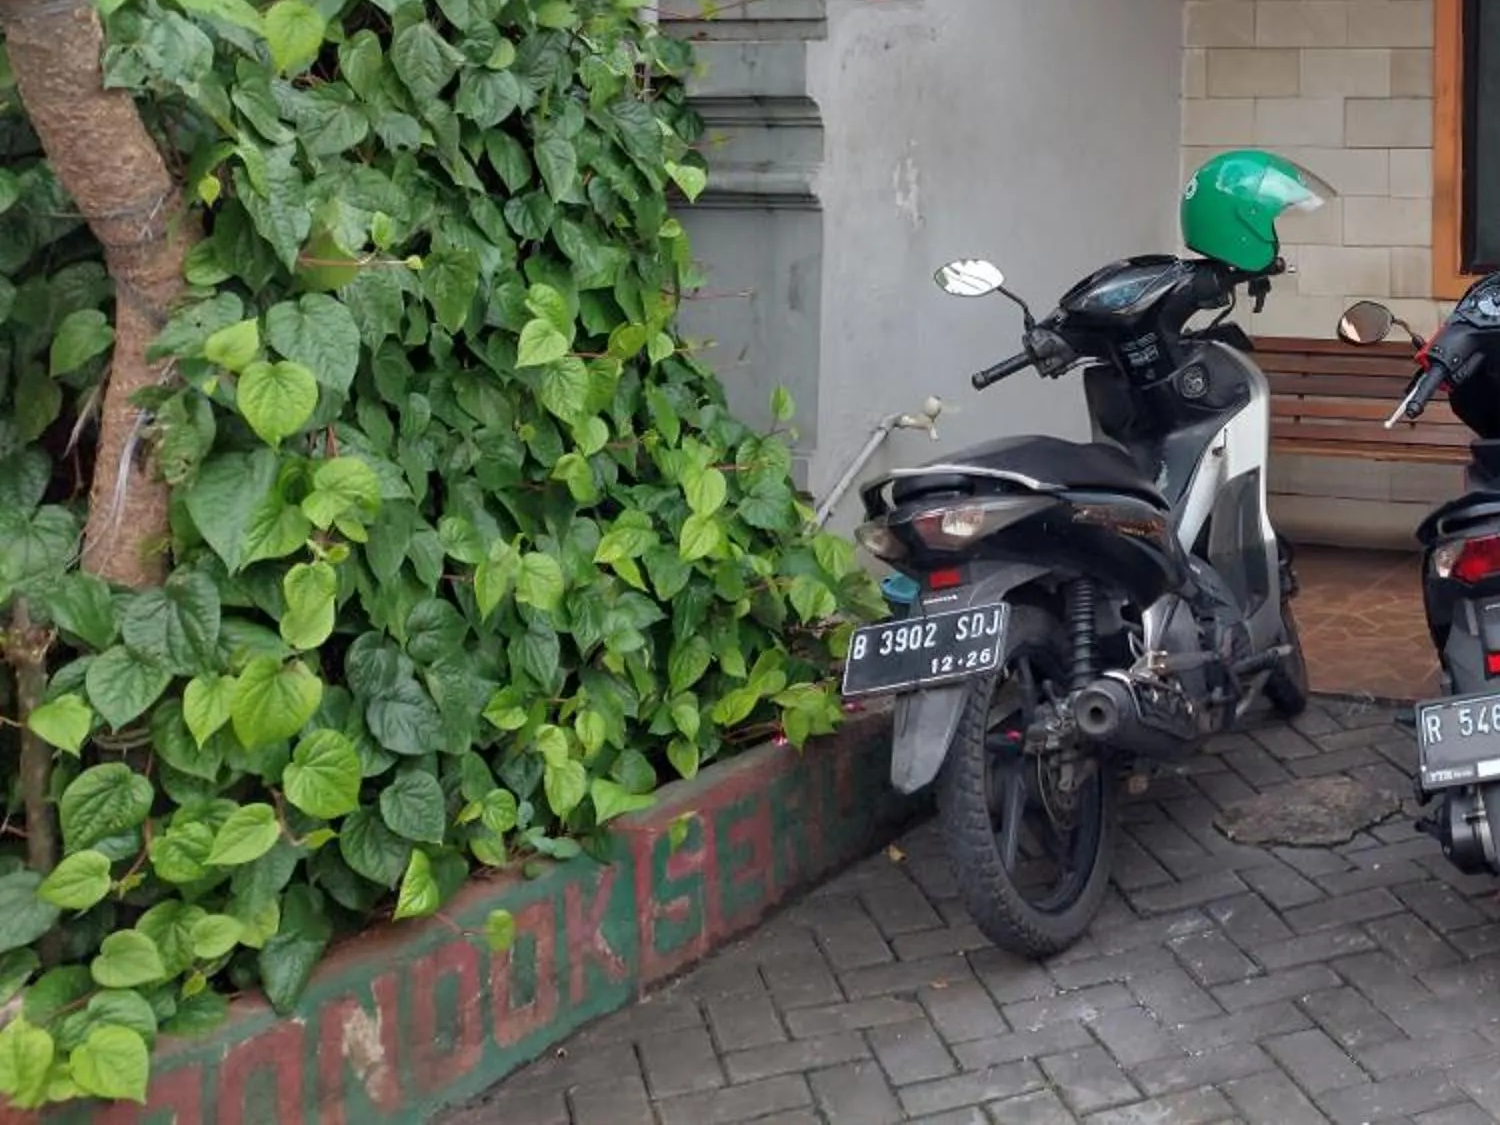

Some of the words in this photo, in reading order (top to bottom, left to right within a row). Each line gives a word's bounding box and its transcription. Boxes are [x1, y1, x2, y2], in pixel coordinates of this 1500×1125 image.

[853, 634, 867, 660] B
[879, 623, 937, 656] 3902
[955, 610, 999, 641] SDJ
[1426, 715, 1442, 744] R
